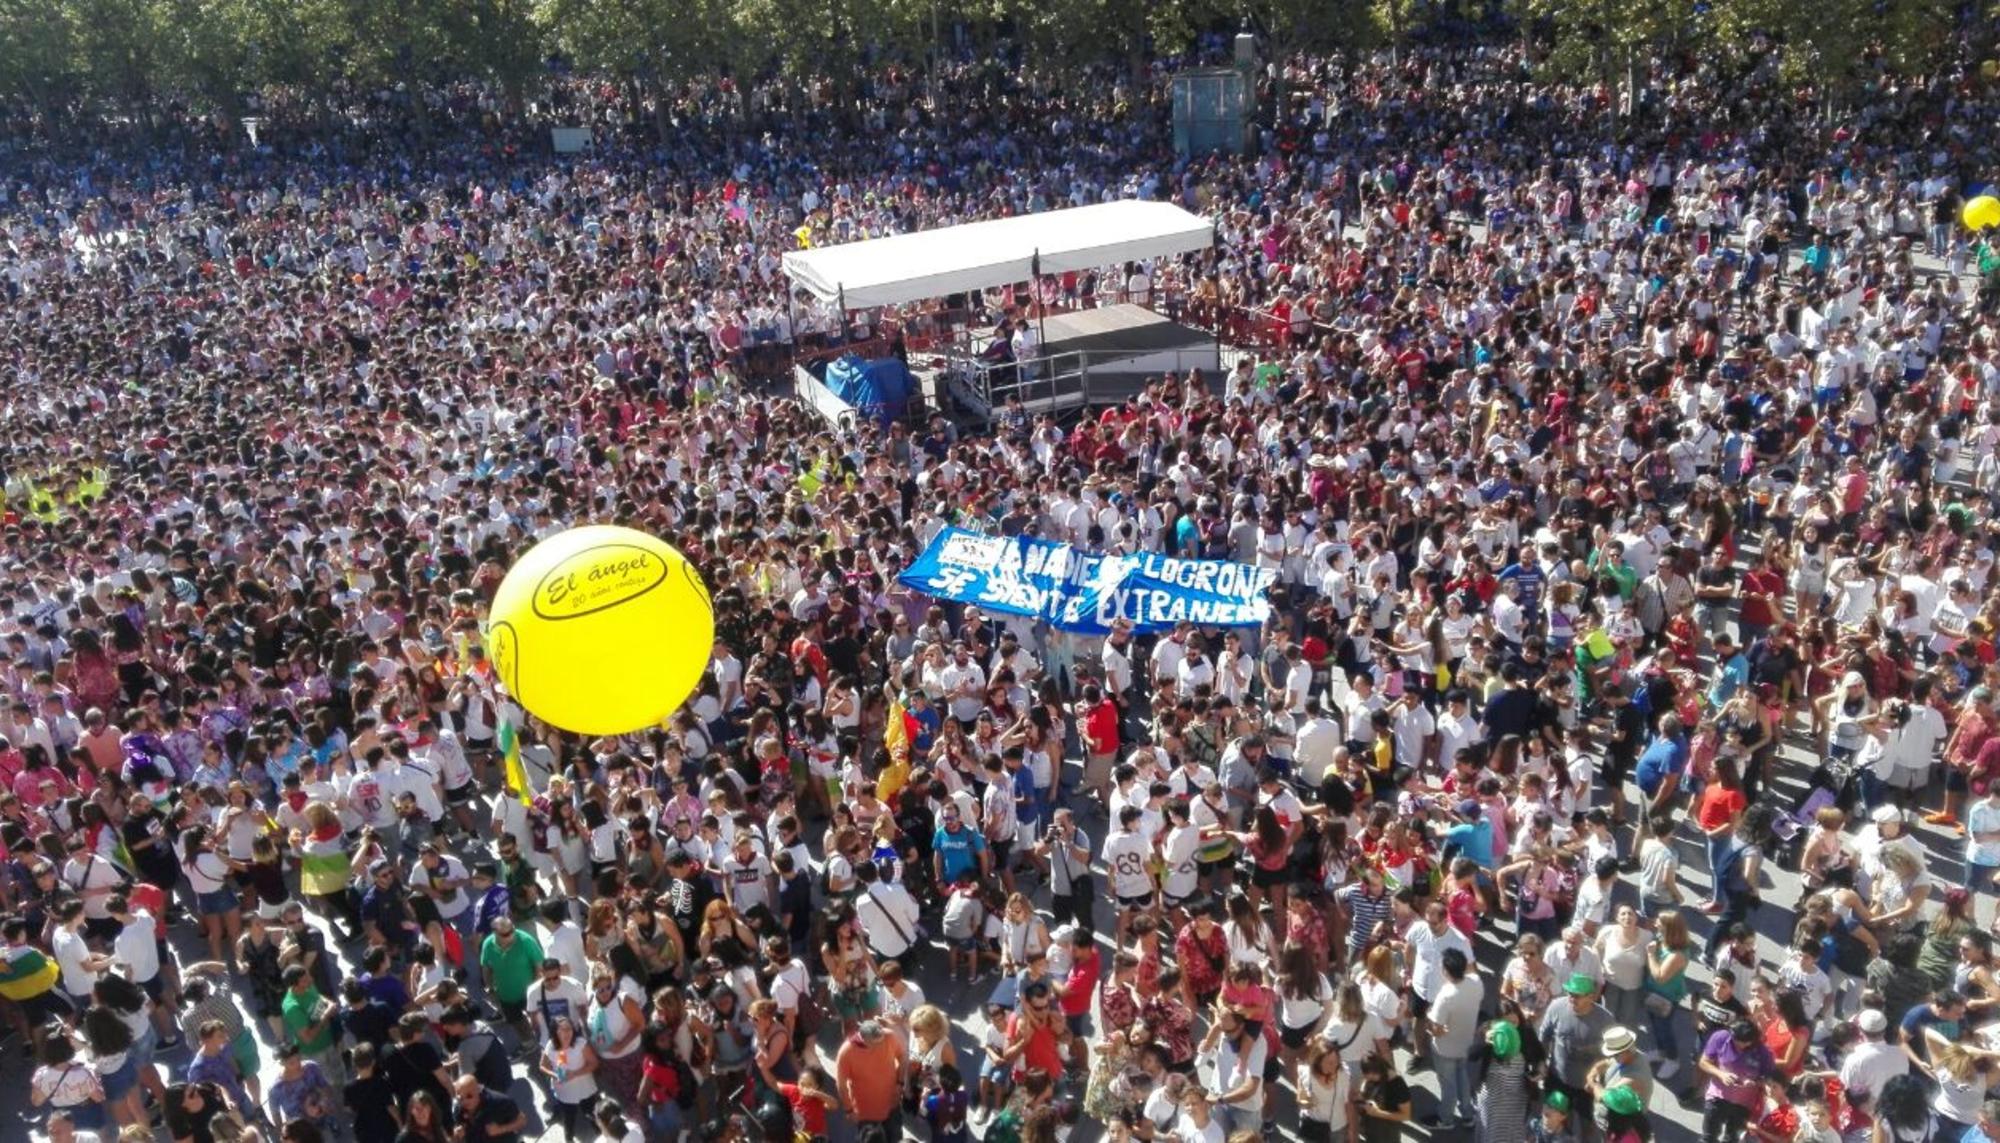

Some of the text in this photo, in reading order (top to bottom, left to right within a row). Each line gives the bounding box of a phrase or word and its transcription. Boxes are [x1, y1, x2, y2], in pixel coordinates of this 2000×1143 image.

[547, 553, 651, 605] El ángel
[1116, 851, 1142, 876] 69
